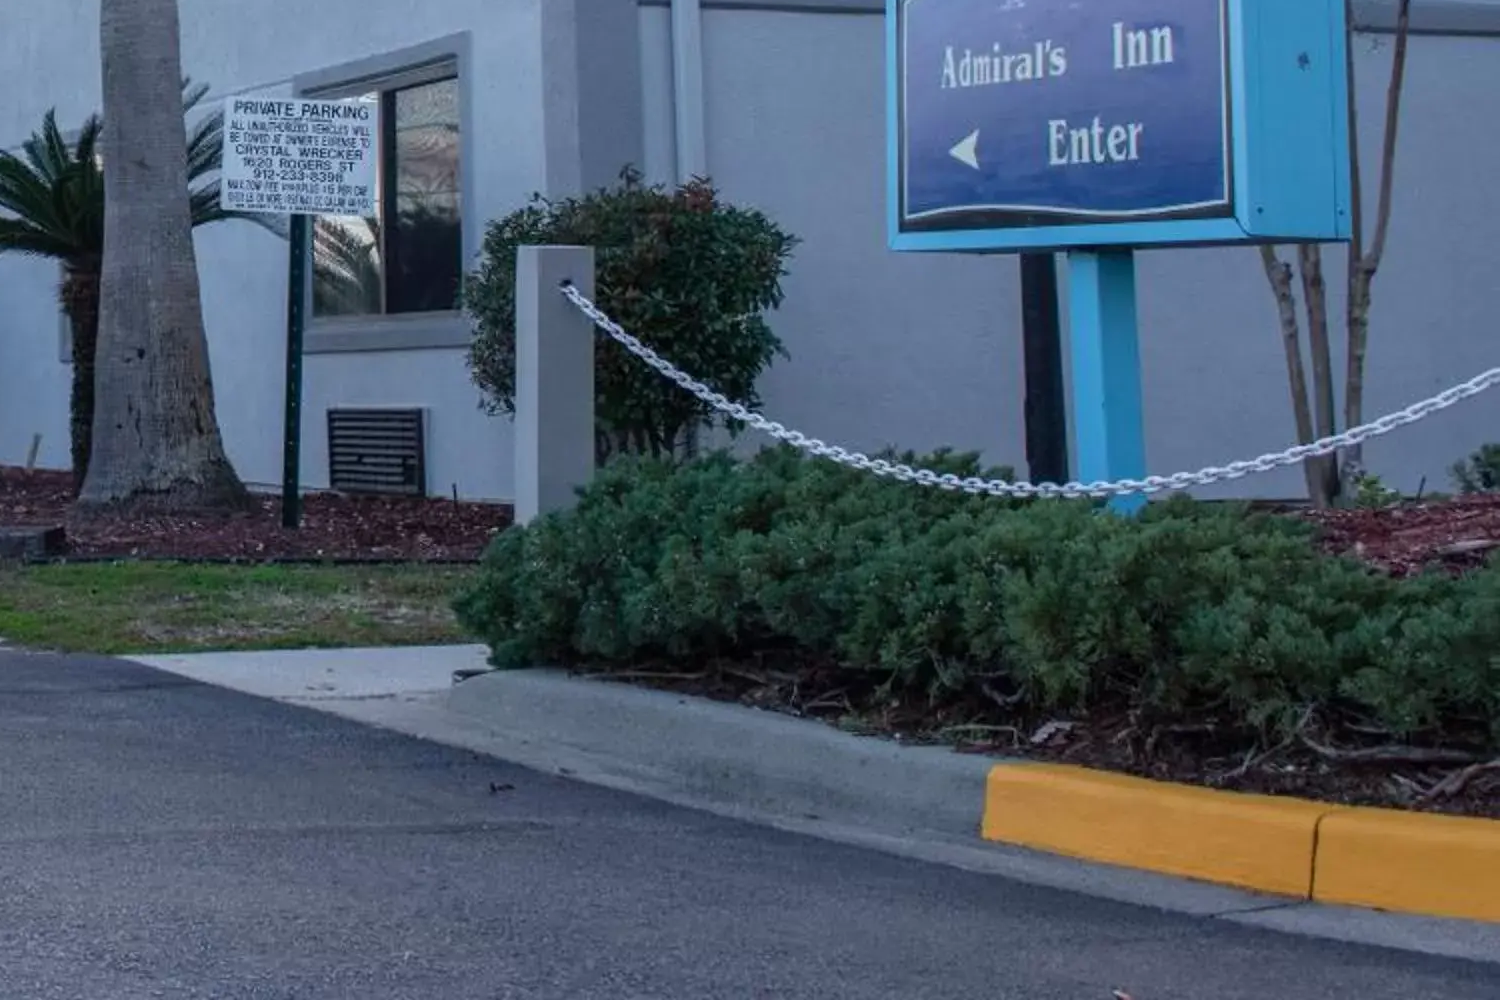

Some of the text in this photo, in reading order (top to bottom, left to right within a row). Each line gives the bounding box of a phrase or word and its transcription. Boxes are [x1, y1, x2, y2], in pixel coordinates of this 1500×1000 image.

[940, 21, 1174, 89] Admiral's Inn
[234, 100, 369, 120] PRIVATE PARKING
[229, 132, 240, 143] BE
[231, 120, 245, 131] ALL
[312, 123, 349, 136] VEHICLES
[351, 125, 370, 137] WILL
[1048, 115, 1144, 167] Enter
[235, 143, 363, 161] CRYSTAL WRECKER
[279, 158, 332, 172] ROGERS
[339, 162, 356, 173] ST
